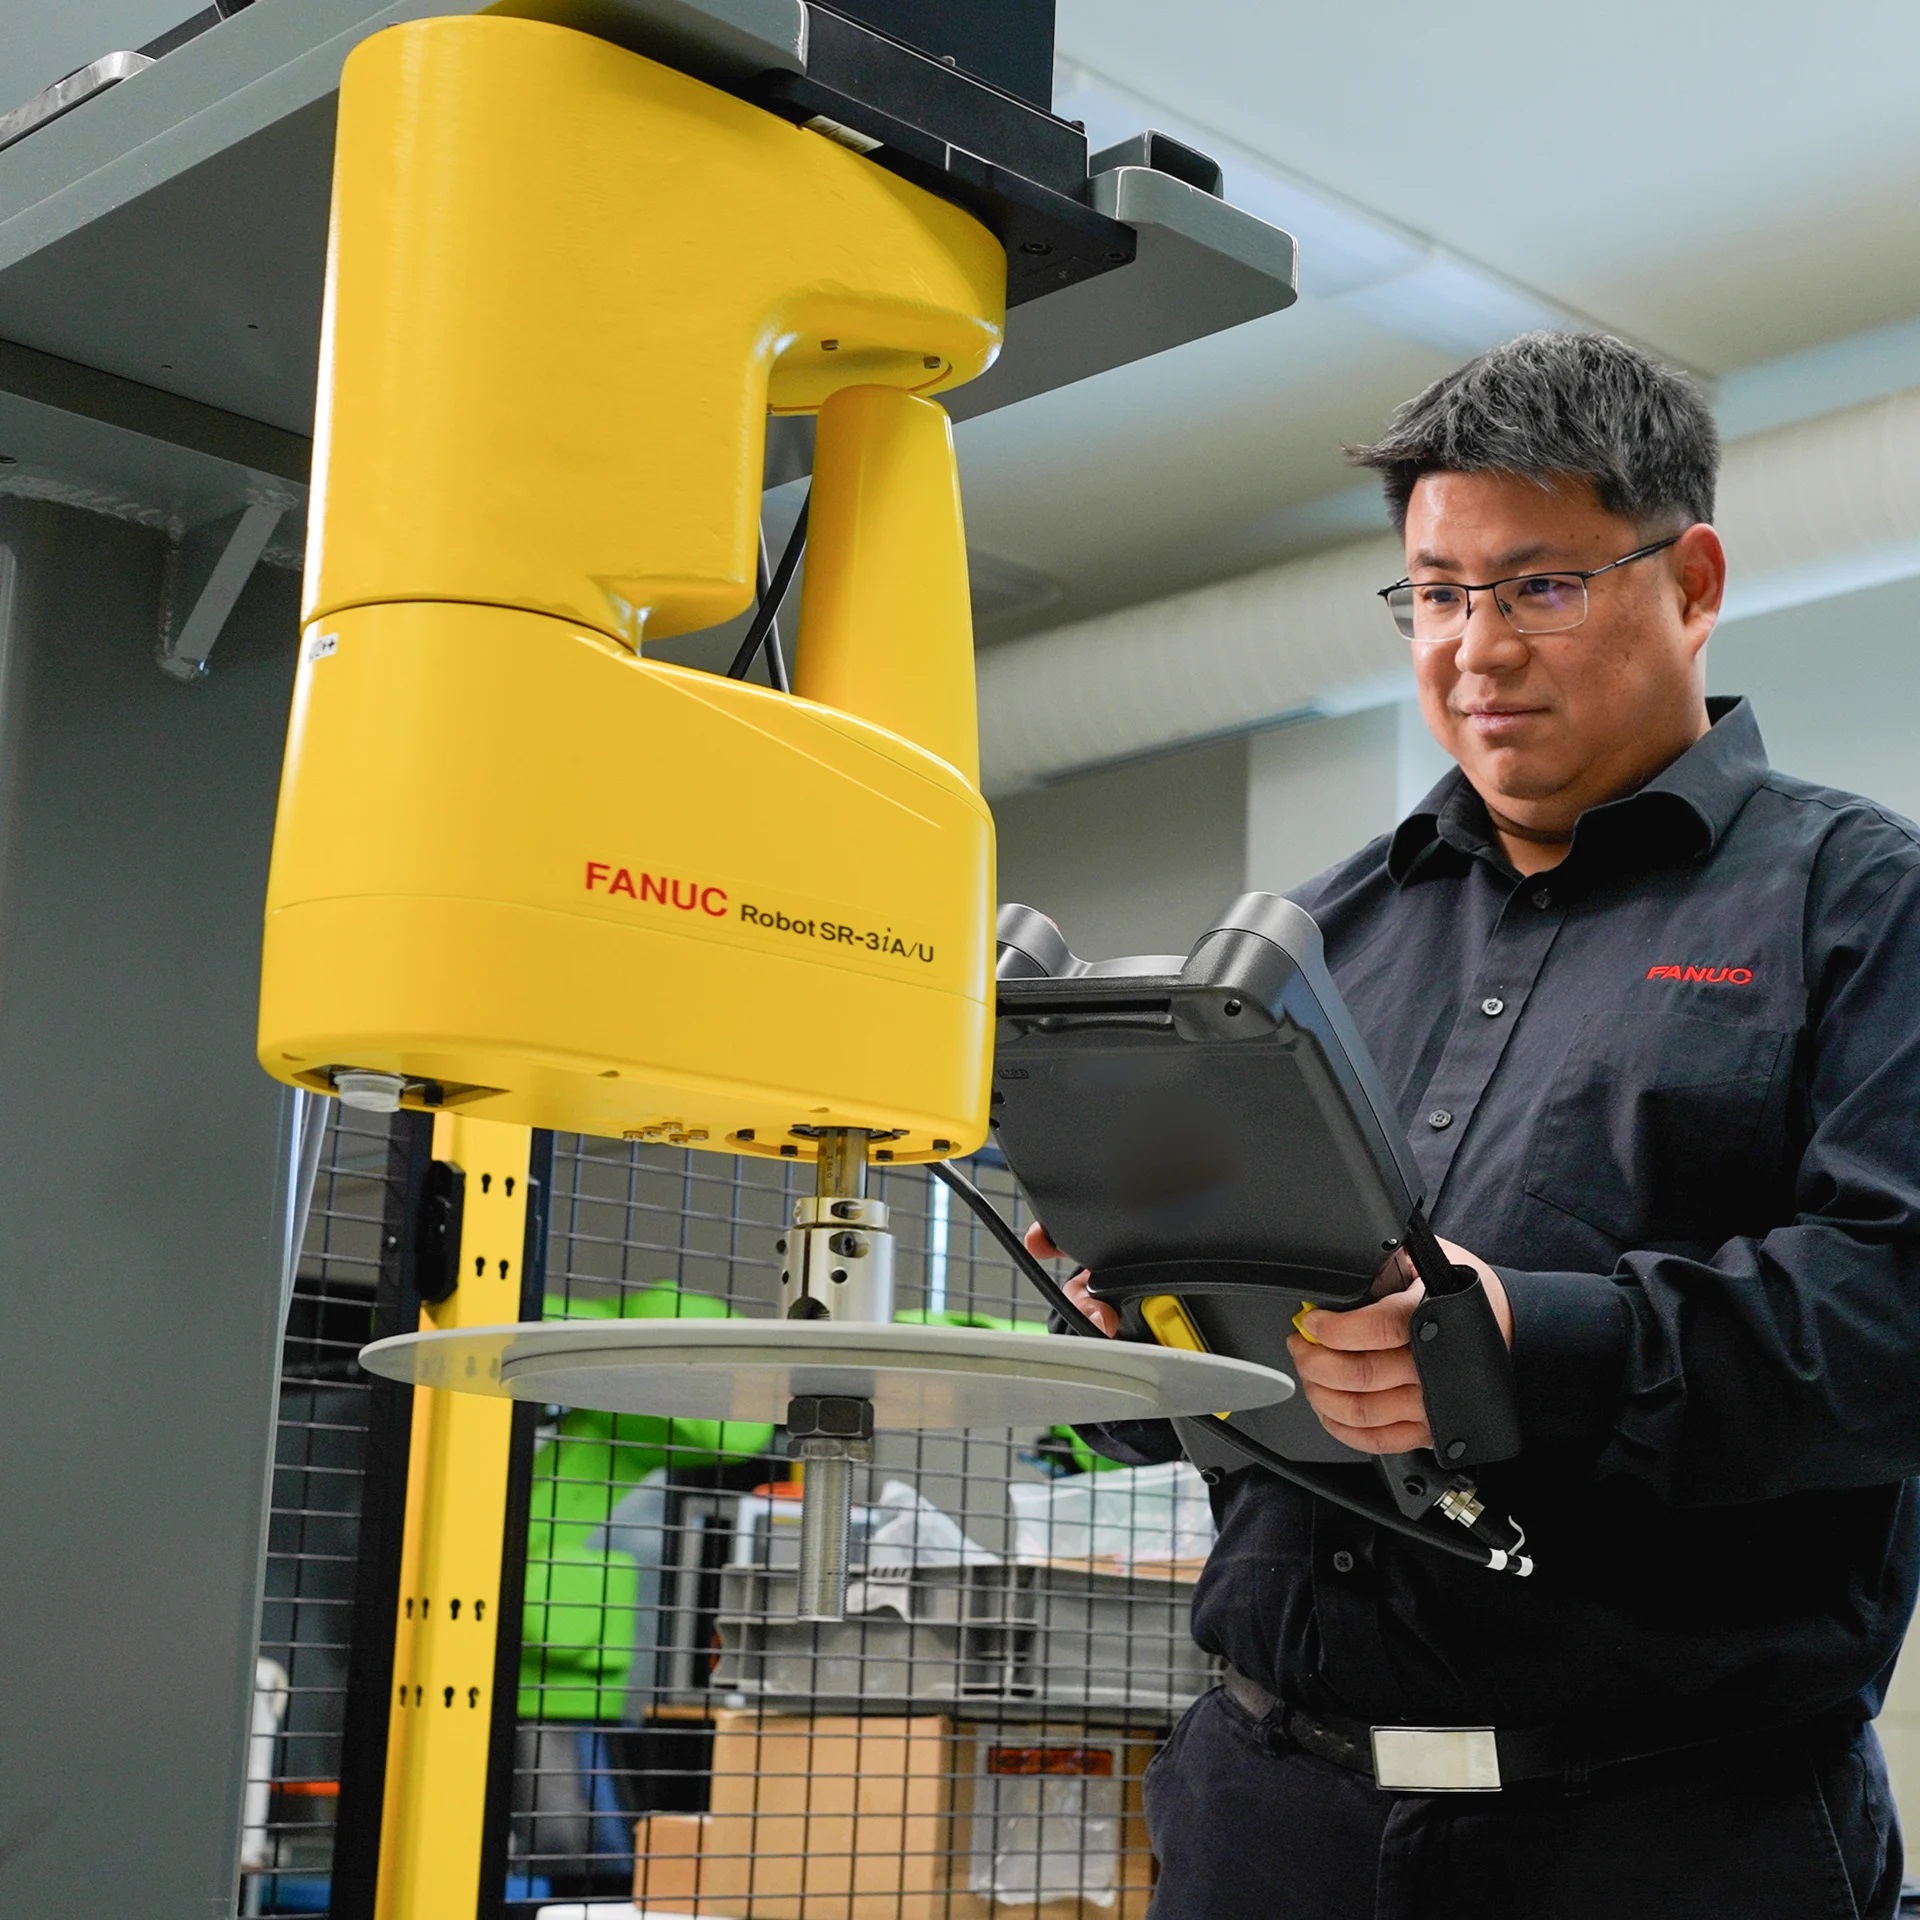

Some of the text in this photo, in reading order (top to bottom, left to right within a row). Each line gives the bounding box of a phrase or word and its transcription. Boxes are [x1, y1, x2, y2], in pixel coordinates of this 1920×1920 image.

[584, 860, 935, 963] FANUC Robot SR-3iA/U
[1645, 965, 1753, 985] FANUC
